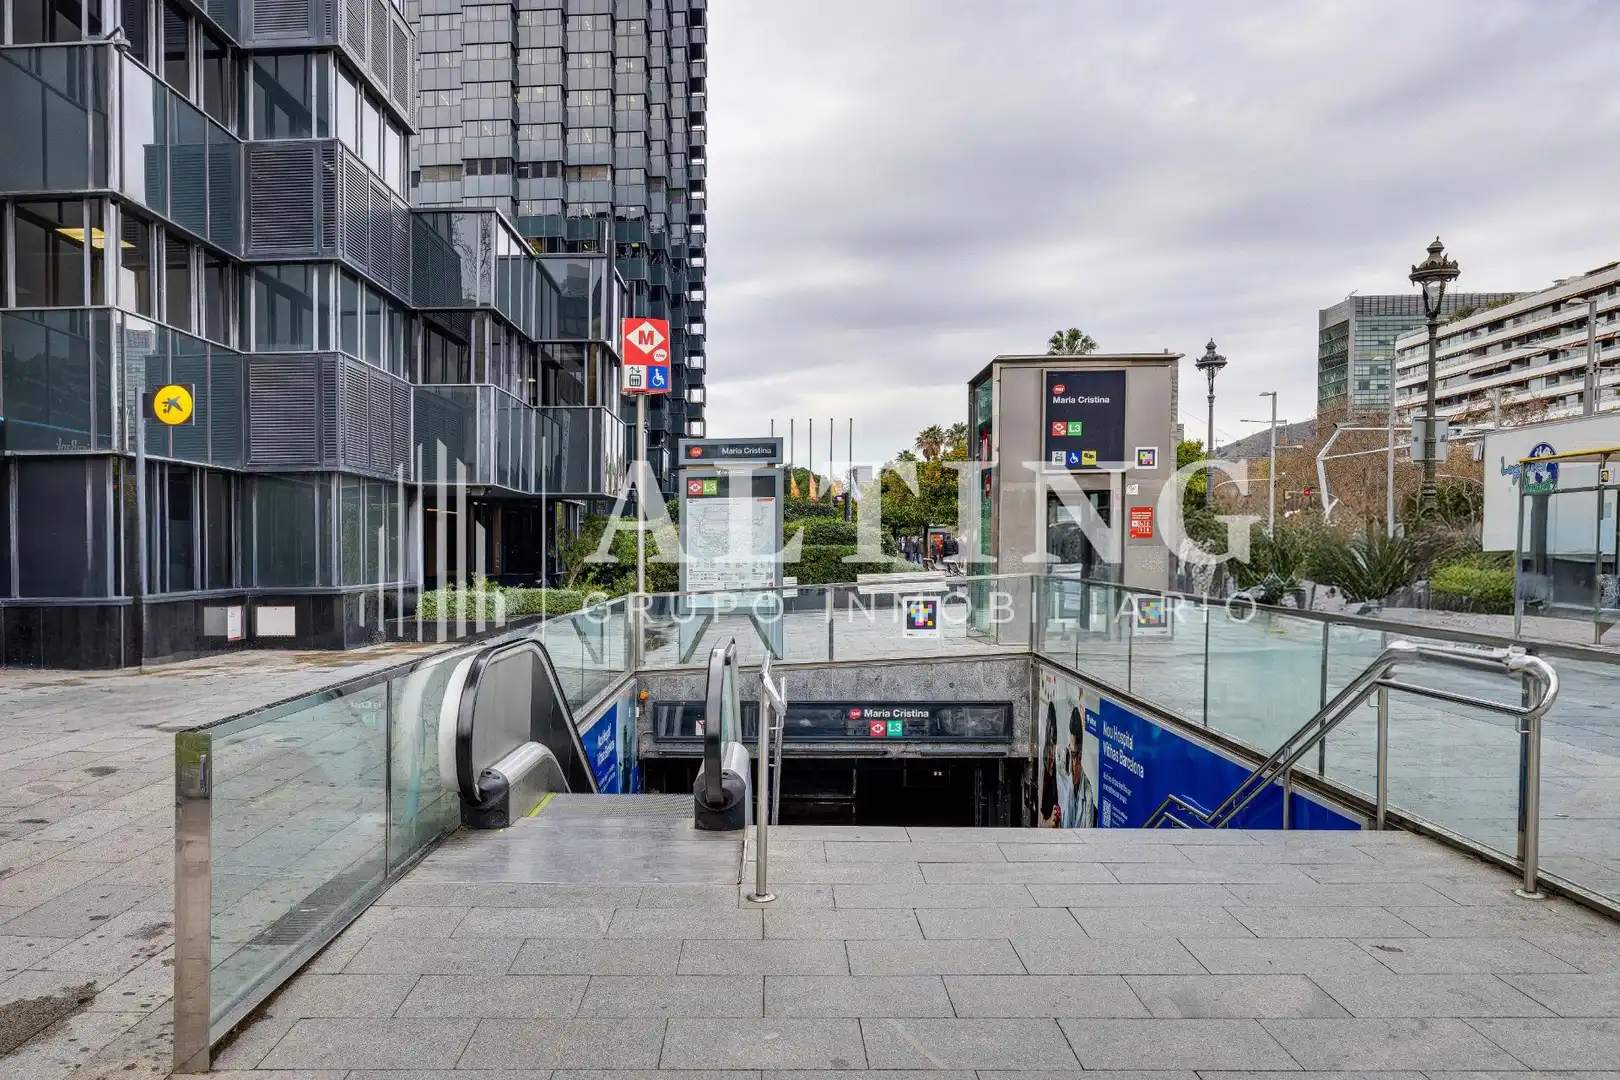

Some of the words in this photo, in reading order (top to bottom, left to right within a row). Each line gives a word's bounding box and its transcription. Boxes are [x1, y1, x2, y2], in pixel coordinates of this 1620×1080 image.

[638, 330, 655, 345] M
[1052, 396, 1076, 404] Maria
[1078, 396, 1110, 404] Cristina
[1069, 424, 1081, 433] L3
[721, 447, 742, 455] Maria
[743, 446, 772, 455] Cristina
[704, 484, 717, 492] L3
[864, 709, 890, 718] Maria
[892, 709, 929, 718] Cristina
[888, 722, 903, 733] L3
[1113, 725, 1134, 751] Hospital
